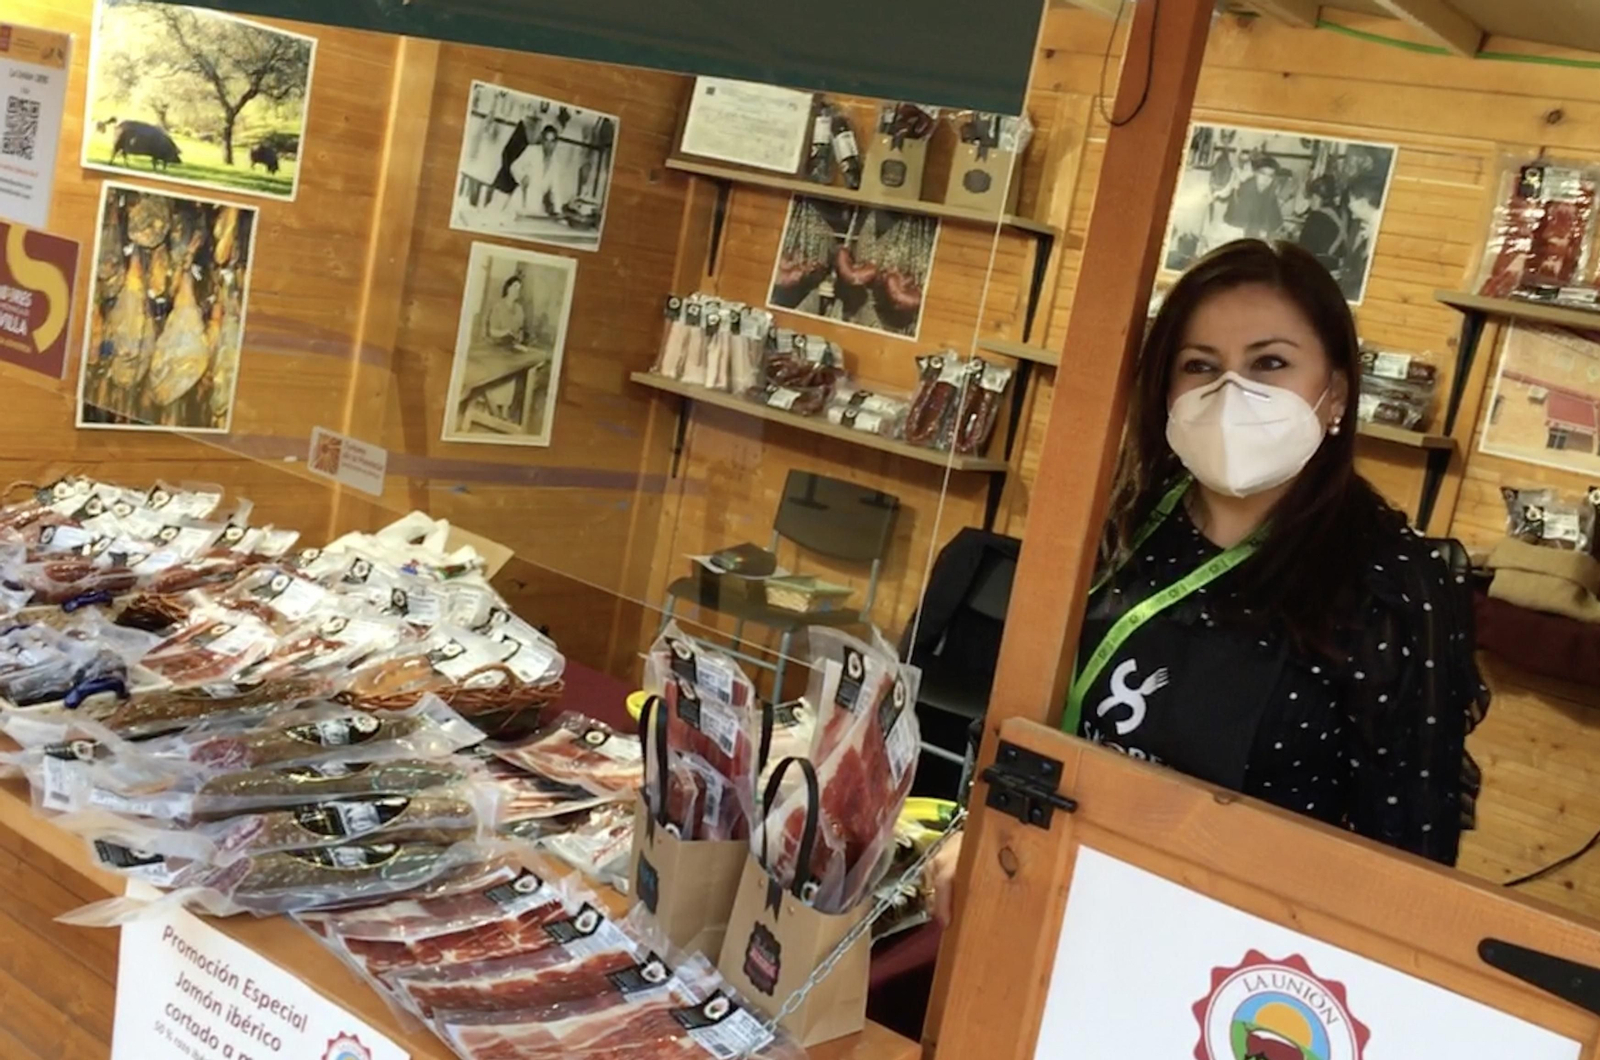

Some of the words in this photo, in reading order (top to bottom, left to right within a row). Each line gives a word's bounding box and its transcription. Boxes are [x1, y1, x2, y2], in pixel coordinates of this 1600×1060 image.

[162, 925, 240, 990] Promoción
[242, 978, 309, 1033] Especial
[175, 971, 222, 1017] Jamón
[225, 1003, 282, 1052] ibérico
[1243, 974, 1268, 993] LA
[1272, 974, 1340, 1026] UNIÓN
[165, 1002, 219, 1050] cortado
[222, 1043, 234, 1059] a
